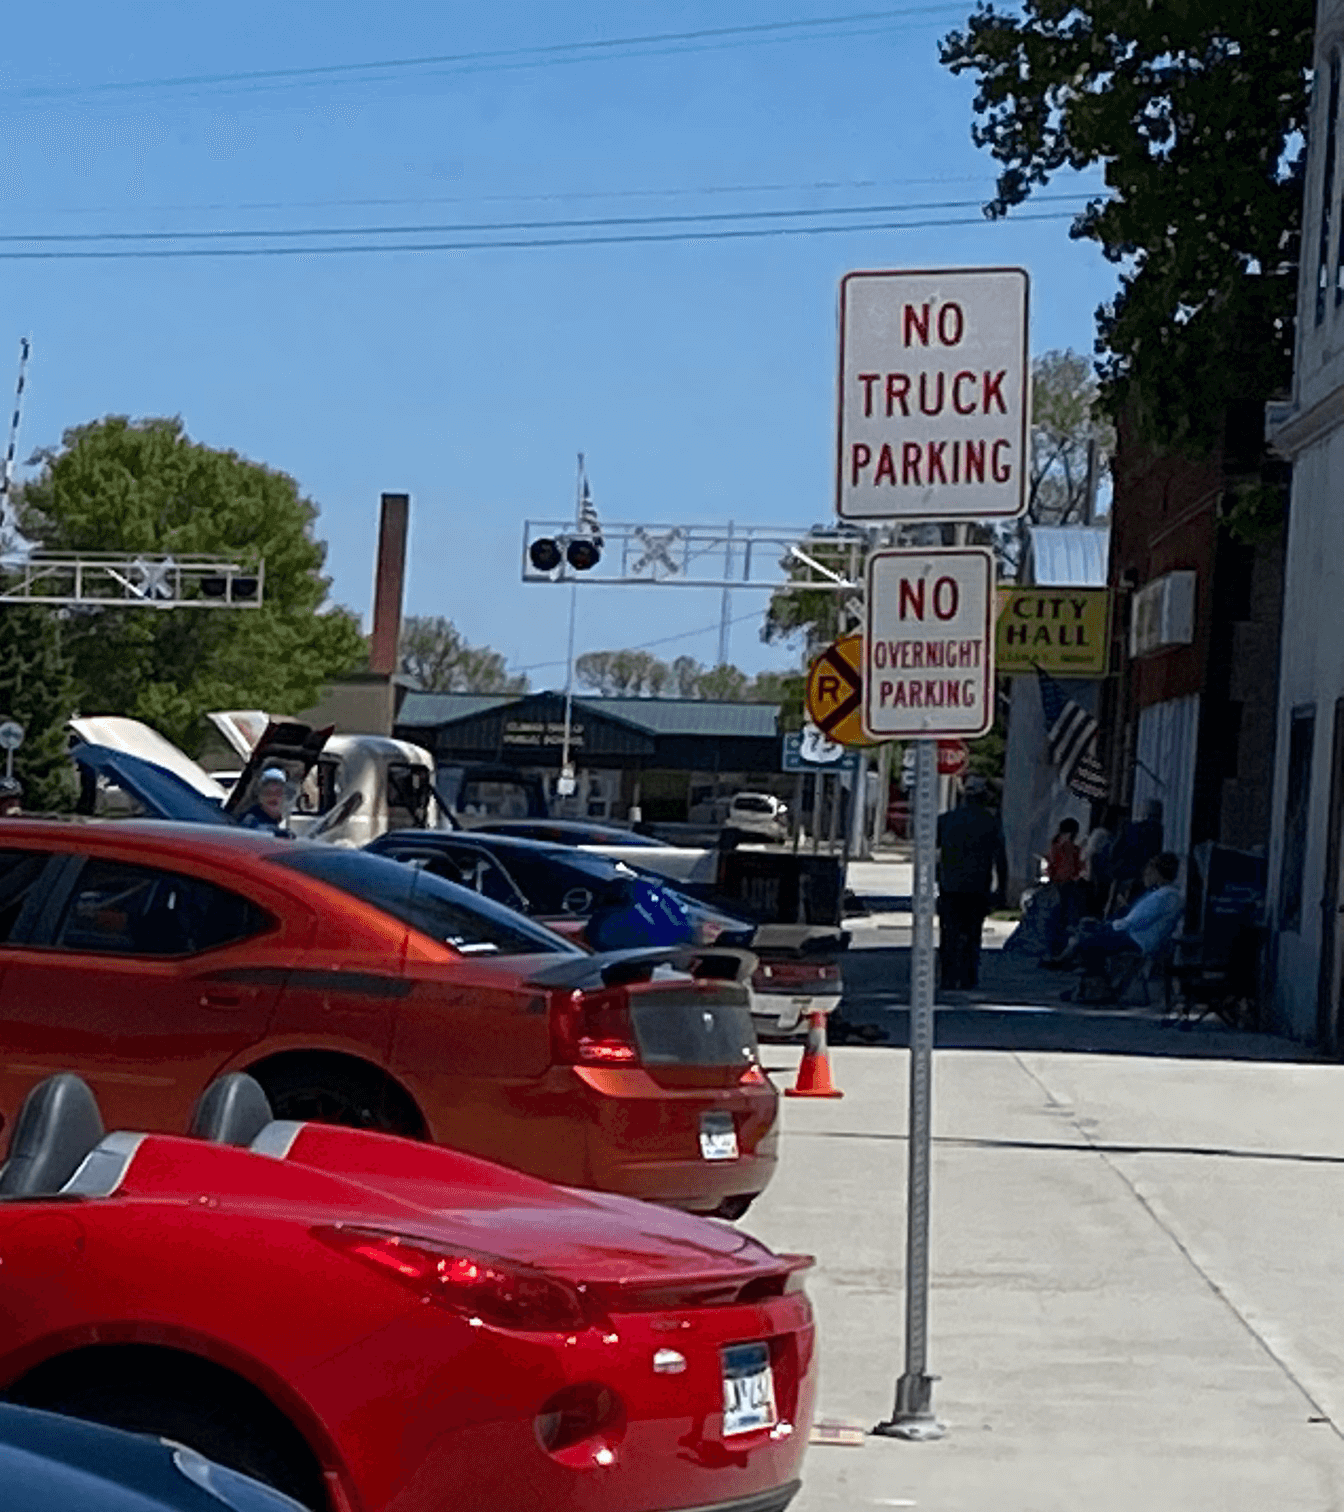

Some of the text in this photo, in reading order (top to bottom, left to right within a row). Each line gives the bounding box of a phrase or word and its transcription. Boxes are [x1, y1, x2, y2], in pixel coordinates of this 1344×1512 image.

[903, 302, 964, 348] NO
[857, 369, 1009, 418] TRUCK
[851, 439, 1012, 487] PARKING
[898, 576, 959, 621] NO
[1012, 597, 1088, 620] CITY
[1006, 624, 1090, 647] HALL
[874, 640, 983, 669] OVERNIGHT
[817, 675, 841, 702] R
[879, 679, 977, 708] PARKING
[939, 748, 965, 765] TOP
